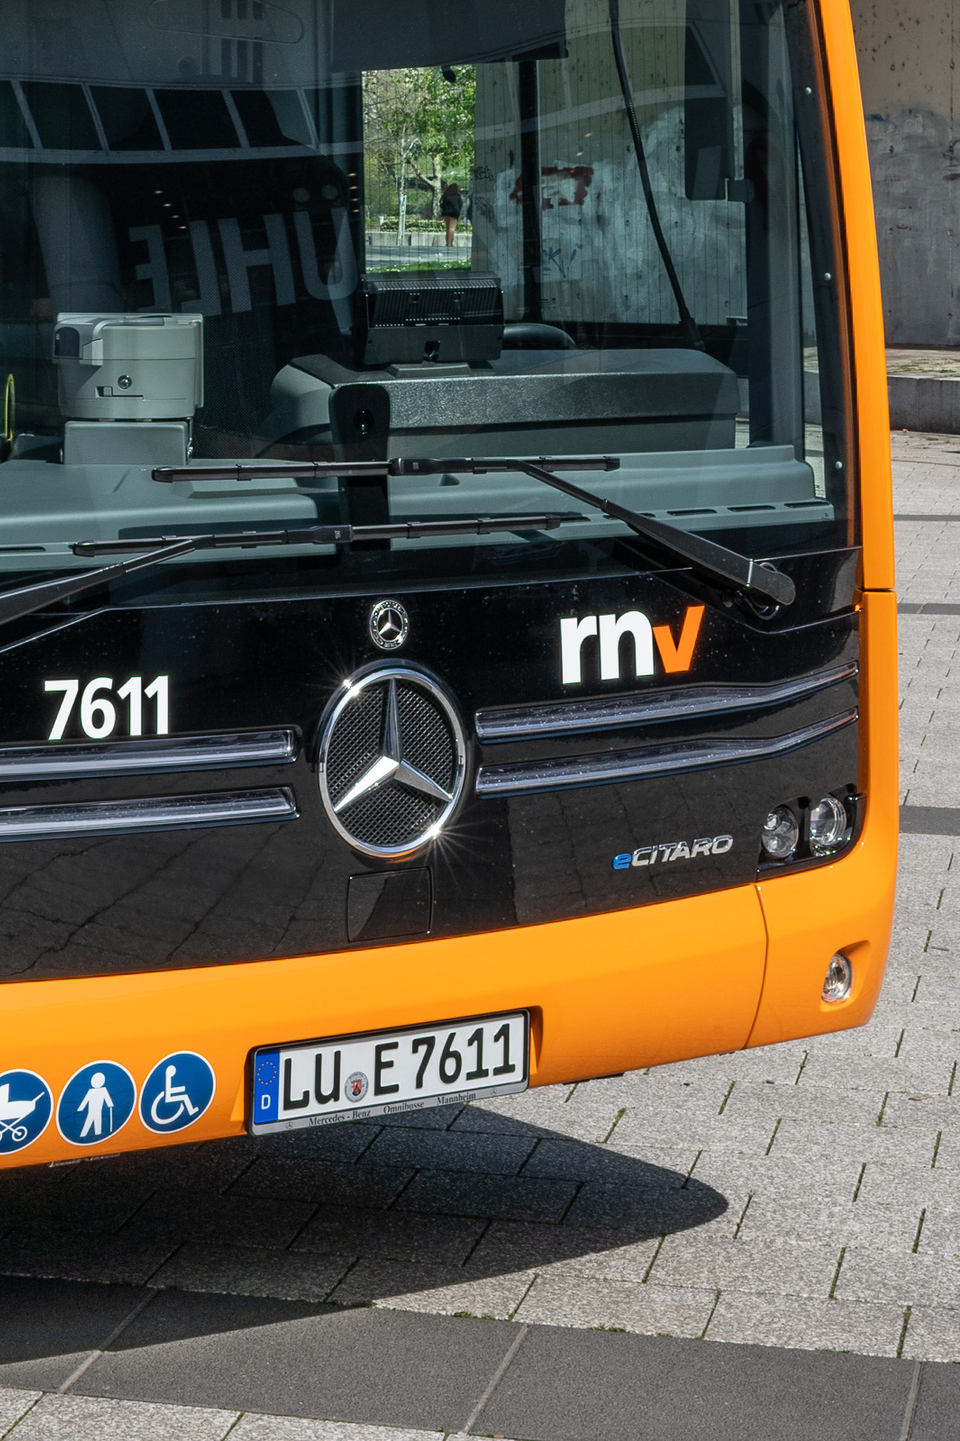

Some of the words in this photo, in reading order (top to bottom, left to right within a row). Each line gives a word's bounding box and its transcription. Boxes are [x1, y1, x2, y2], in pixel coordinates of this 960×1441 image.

[559, 604, 705, 685] rnv
[44, 674, 170, 741] 7611
[611, 834, 734, 870] eCITARO
[260, 1094, 272, 1110] D
[283, 1050, 341, 1111] LU
[411, 1022, 516, 1090] 7611
[383, 1100, 426, 1115] Omnibusse
[436, 1092, 477, 1107] Mannheim
